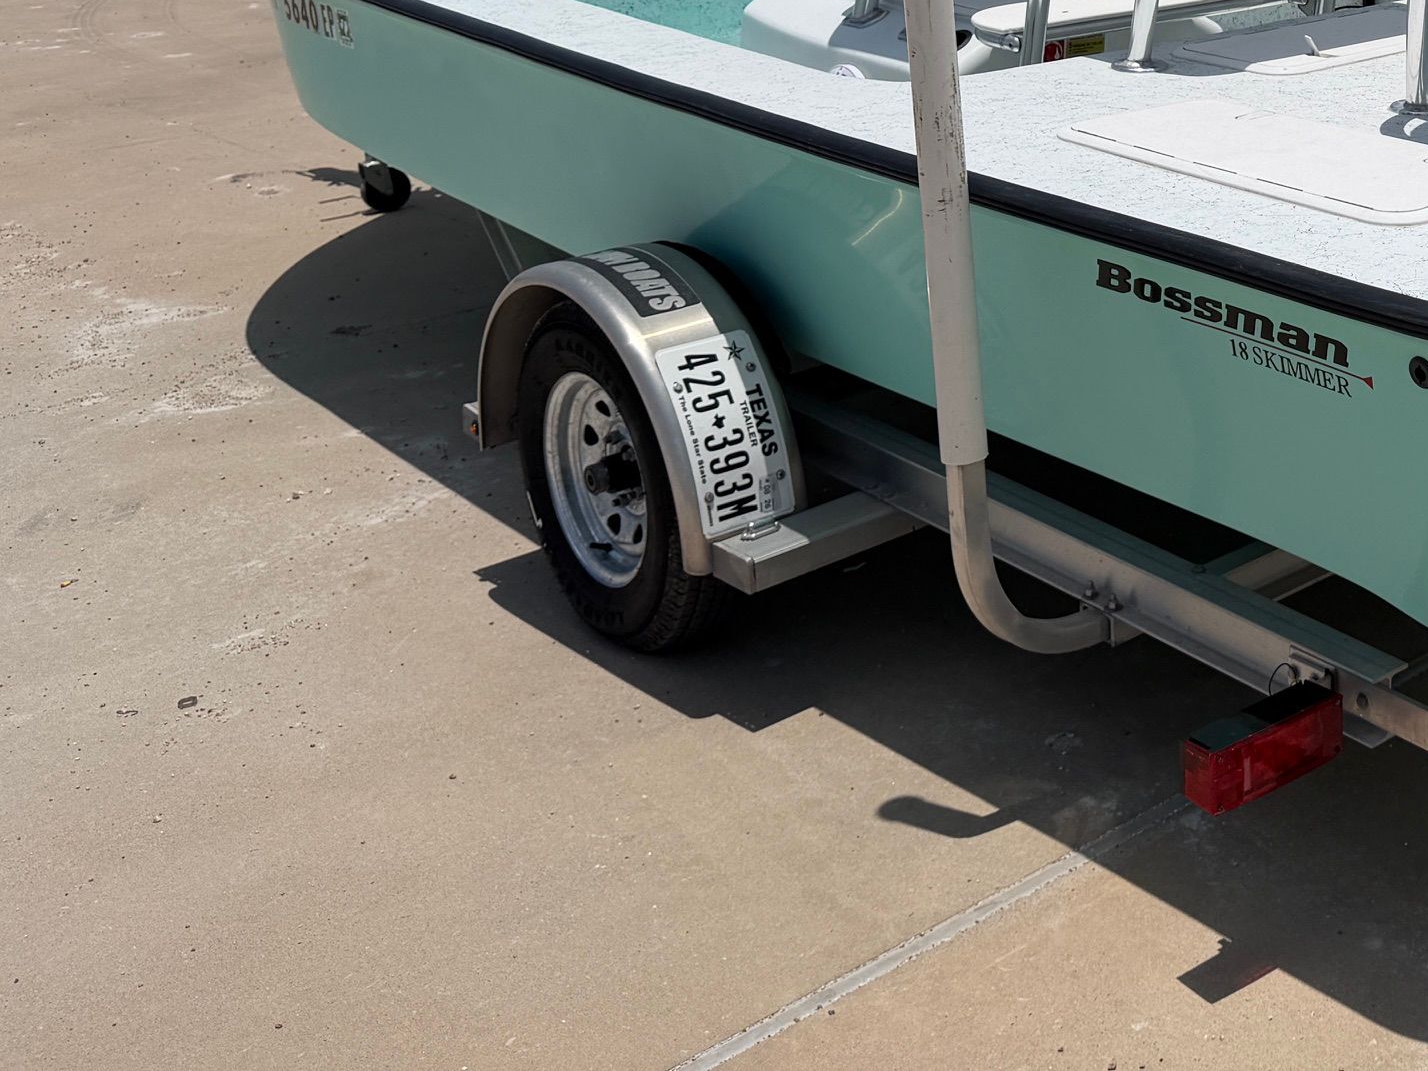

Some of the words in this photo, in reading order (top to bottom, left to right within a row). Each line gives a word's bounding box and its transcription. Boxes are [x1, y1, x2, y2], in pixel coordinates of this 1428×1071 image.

[1096, 258, 1350, 368] Bossman
[1228, 338, 1250, 362] 18
[1252, 345, 1353, 398] SKIMMER
[678, 396, 687, 412] The
[685, 413, 696, 437] Lone
[692, 438, 702, 460] Star
[698, 460, 708, 485] State
[738, 399, 759, 447] TRAILER
[745, 383, 779, 457] TEXAS
